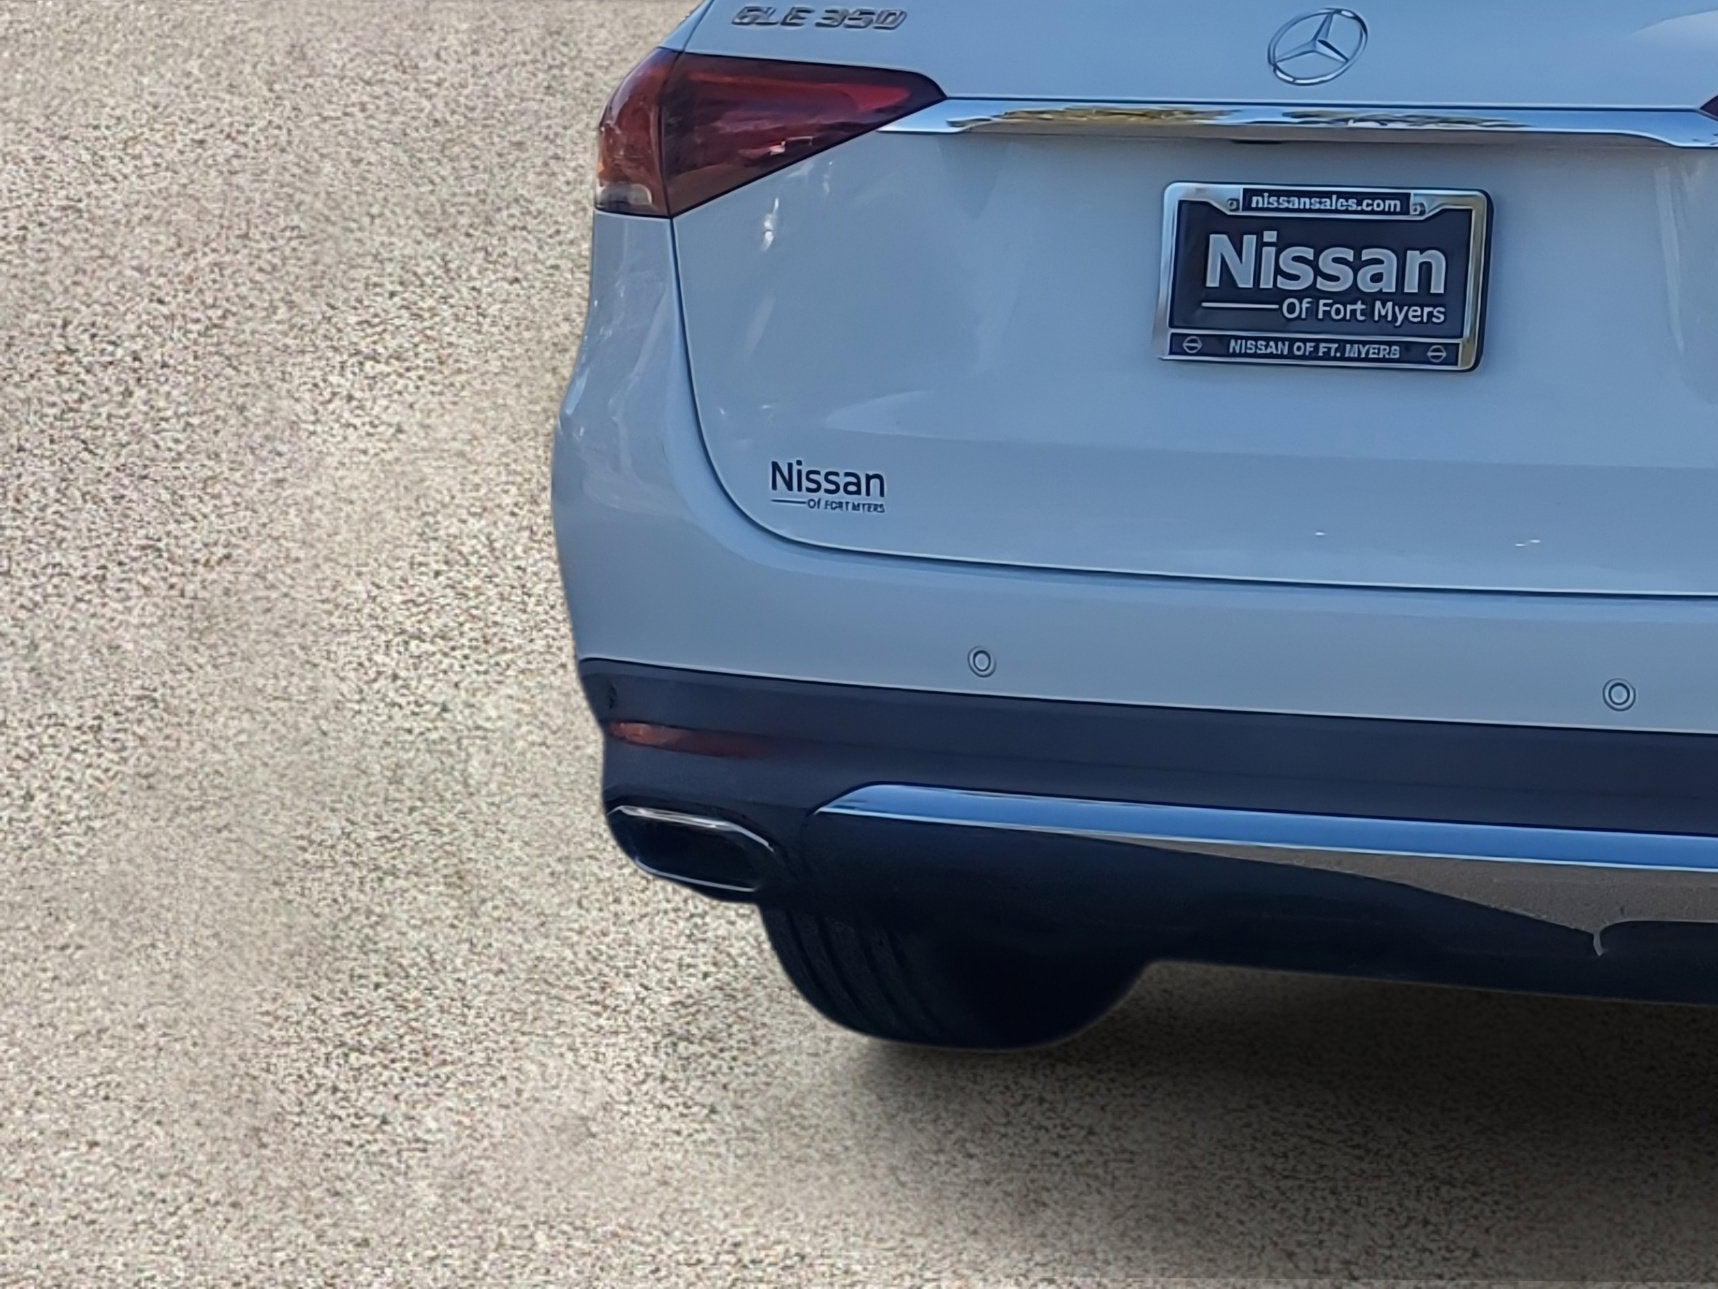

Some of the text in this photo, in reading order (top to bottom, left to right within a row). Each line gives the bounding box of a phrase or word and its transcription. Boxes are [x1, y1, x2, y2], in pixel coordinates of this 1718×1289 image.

[731, 5, 908, 31] GLE 350
[1251, 192, 1401, 212] nissansales.com
[1205, 230, 1447, 294] Nissan
[1282, 298, 1446, 327] Of Fort Myers
[1229, 339, 1290, 356] NISSAN
[1293, 341, 1314, 356] OF
[1345, 344, 1400, 359] MYERS
[771, 459, 885, 498] Nissan
